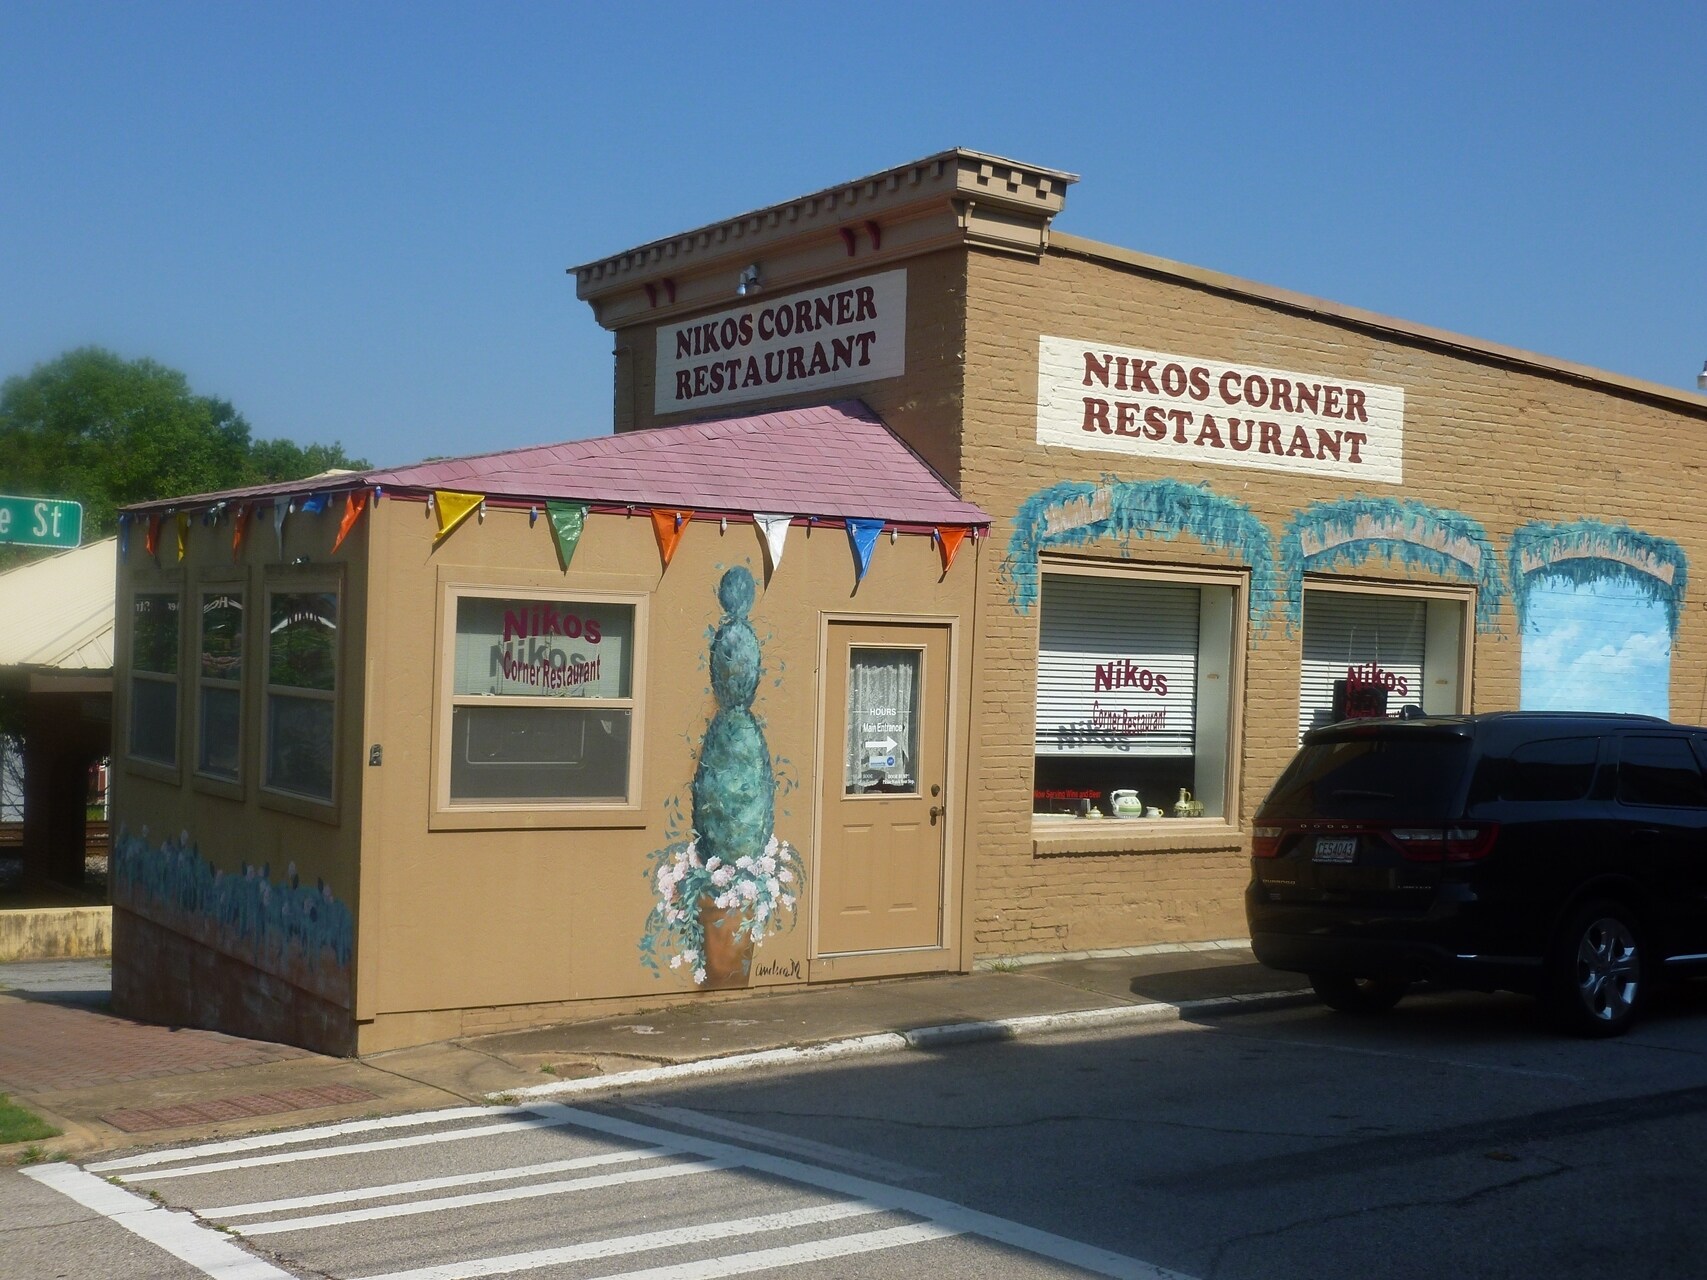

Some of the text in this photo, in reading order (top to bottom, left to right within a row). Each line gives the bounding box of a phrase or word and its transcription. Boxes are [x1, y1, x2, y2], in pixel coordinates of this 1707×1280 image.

[675, 285, 878, 359] NIKOS CORNER
[675, 330, 876, 400] RESTAURANT
[1082, 351, 1368, 422] NIKOS CORNER
[1081, 397, 1367, 463] RESTAURANT
[32, 502, 62, 538] St
[503, 603, 601, 645] Nikos
[503, 651, 601, 690] Corner Restaurant
[1094, 659, 1168, 697] Nikos
[1345, 661, 1408, 697] Nikos
[863, 723, 903, 733] Main Entrance
[869, 708, 897, 716] HOURS
